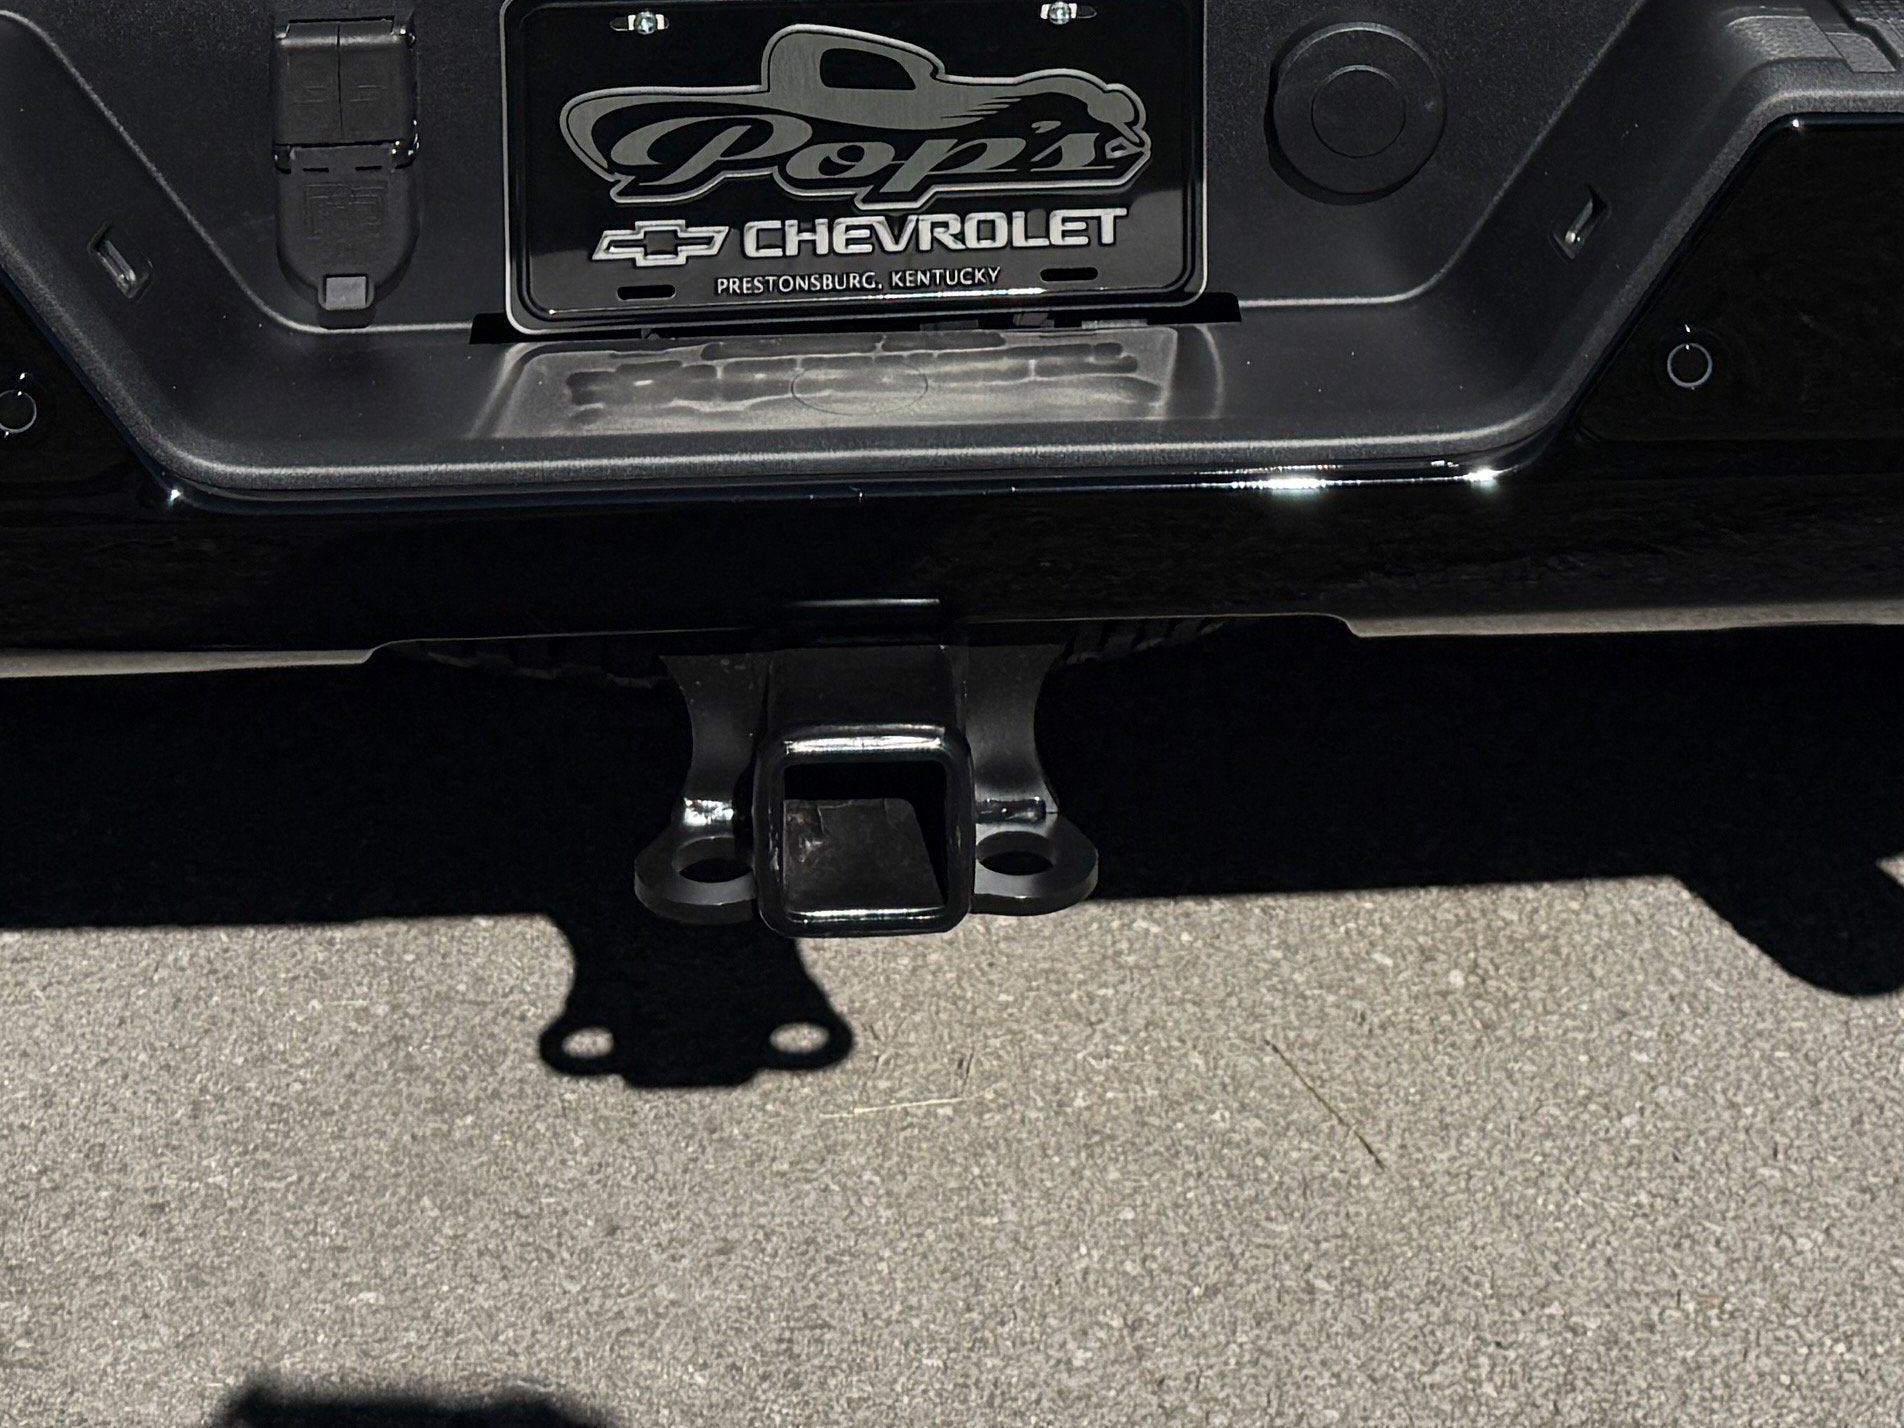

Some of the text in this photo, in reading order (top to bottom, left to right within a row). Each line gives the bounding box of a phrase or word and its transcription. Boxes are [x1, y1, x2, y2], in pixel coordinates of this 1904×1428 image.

[610, 115, 1115, 193] Pop's
[742, 207, 1128, 259] CHEVROLET
[891, 265, 1002, 288] KENTUCKY
